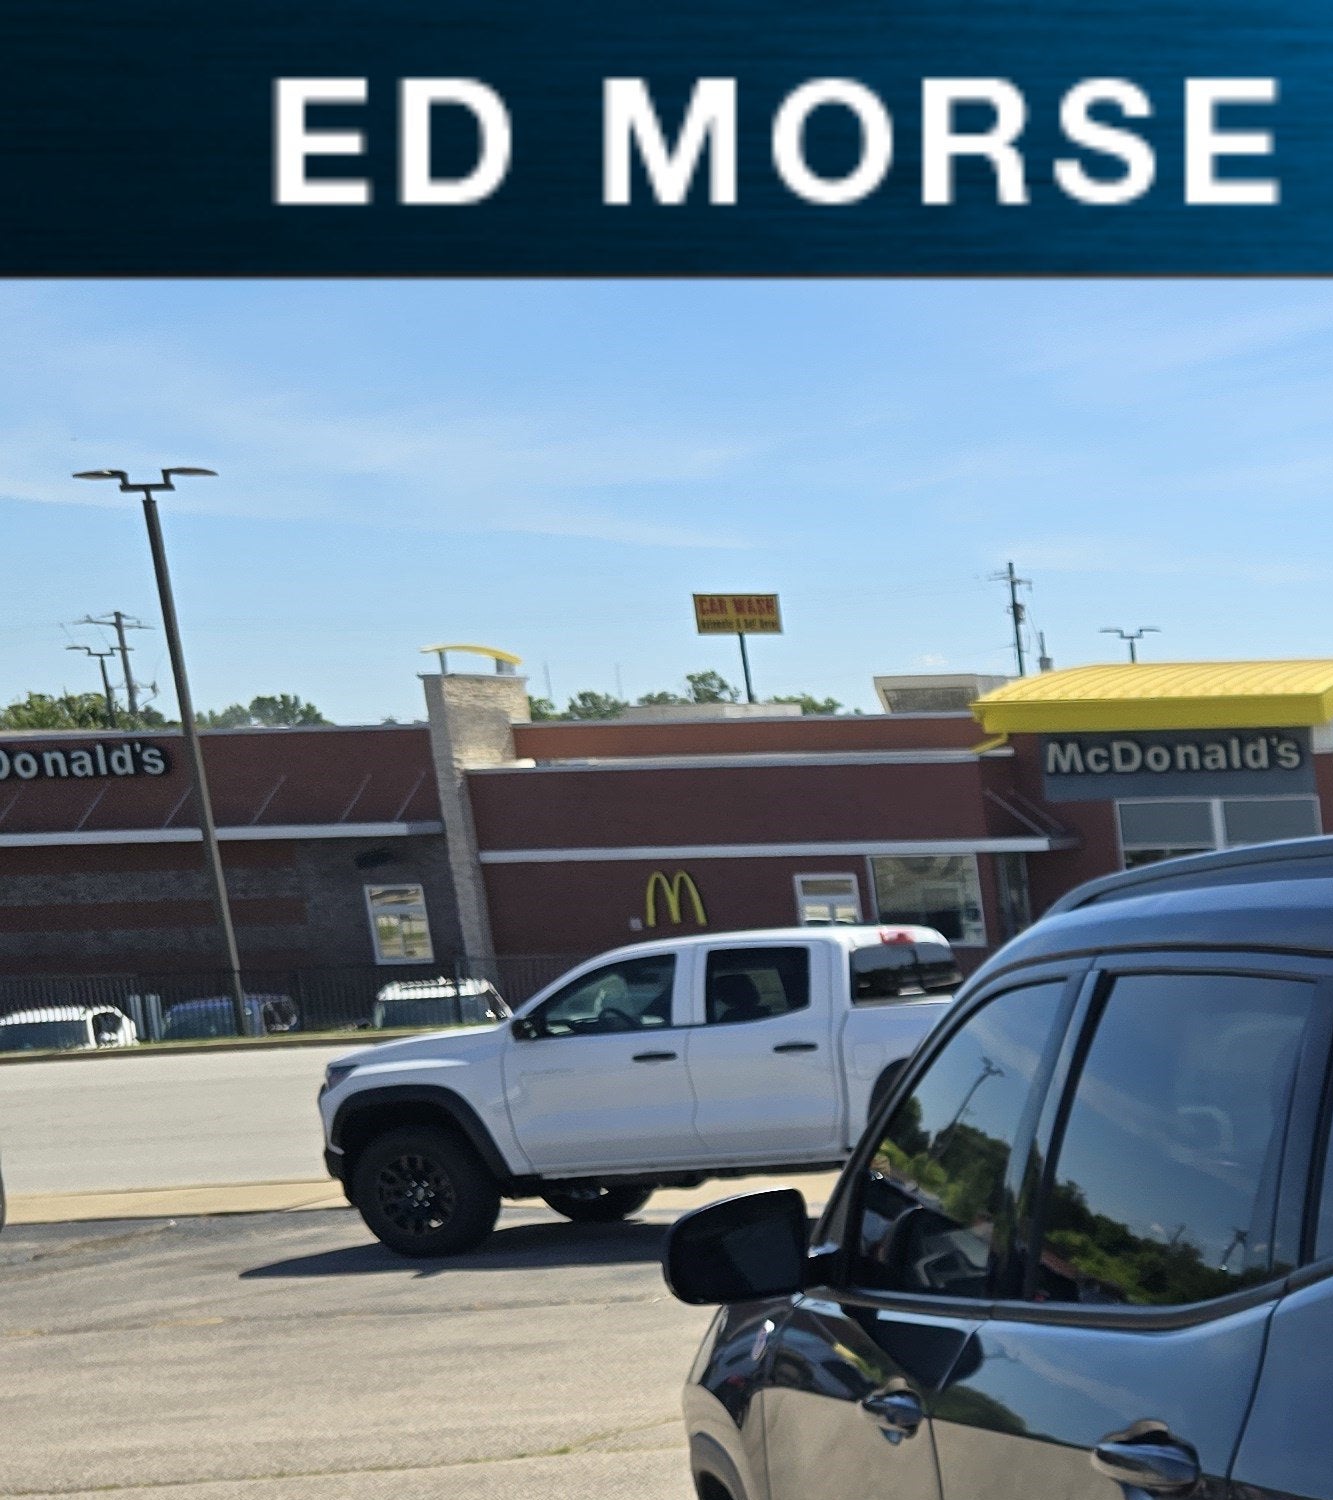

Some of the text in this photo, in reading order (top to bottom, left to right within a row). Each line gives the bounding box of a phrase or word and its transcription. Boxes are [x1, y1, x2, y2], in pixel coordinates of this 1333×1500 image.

[699, 598, 775, 615] CAR WASH
[1047, 735, 1301, 774] McDonald's
